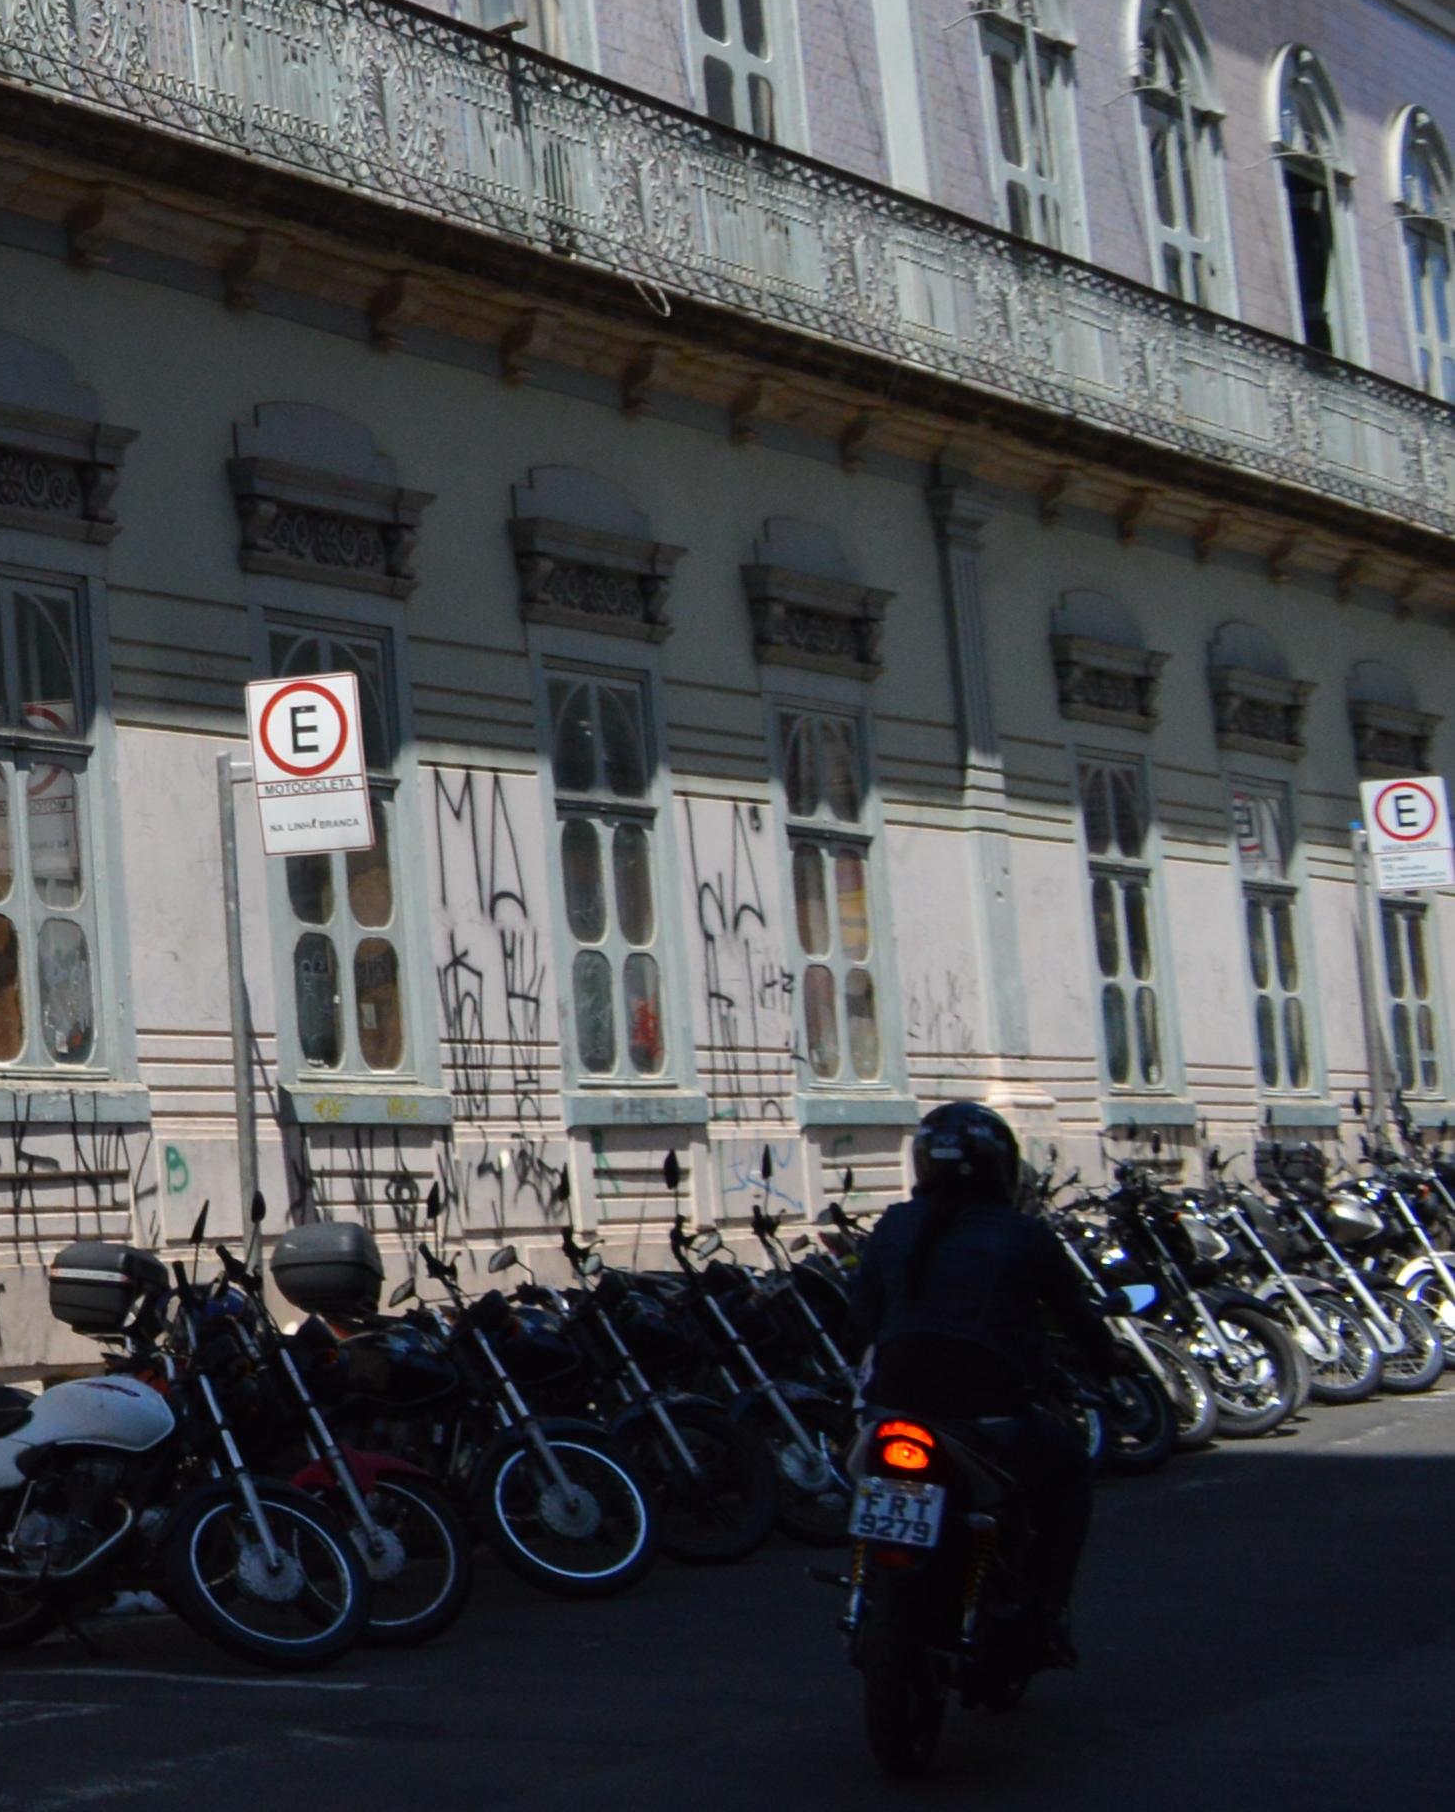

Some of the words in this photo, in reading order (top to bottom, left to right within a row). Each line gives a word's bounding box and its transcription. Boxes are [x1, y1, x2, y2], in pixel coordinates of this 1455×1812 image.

[290, 705, 319, 754] E
[265, 778, 355, 795] MOTOCICLETA
[270, 825, 284, 833] NA
[319, 818, 360, 830] BRANCA
[1395, 794, 1417, 827] E
[858, 1513, 932, 1543] 9279
